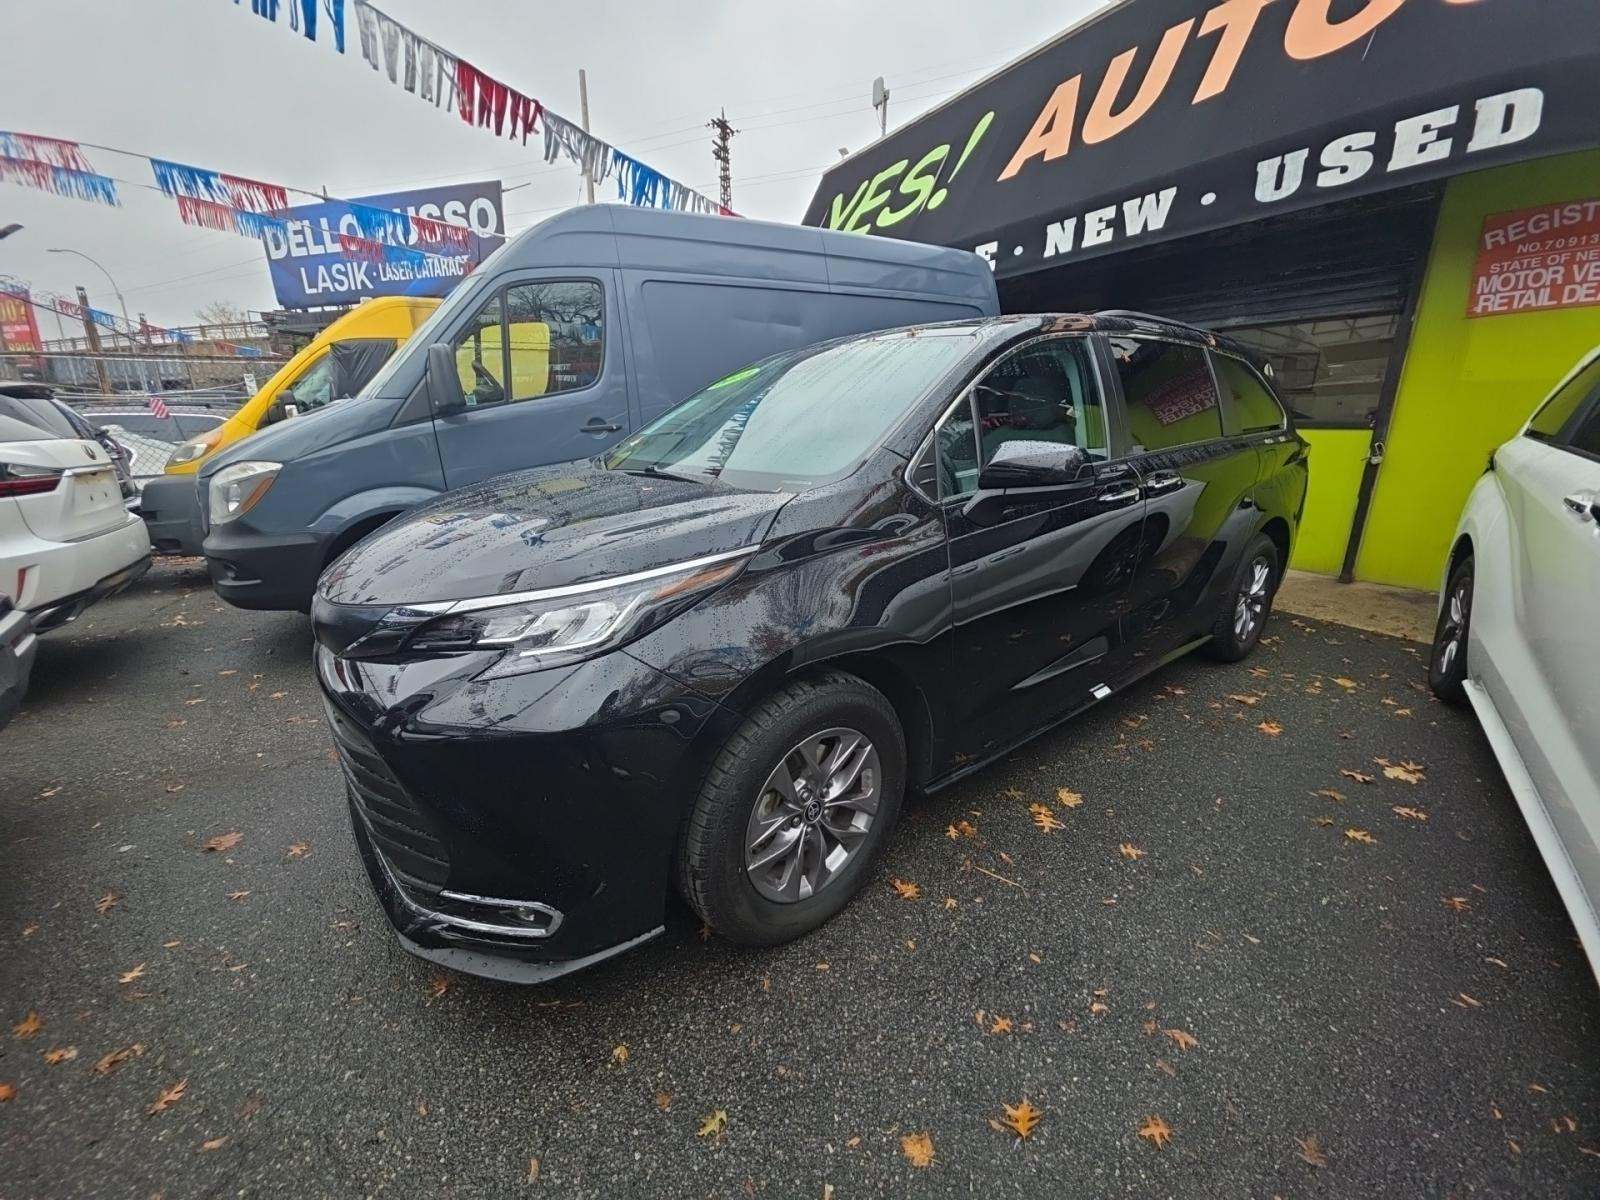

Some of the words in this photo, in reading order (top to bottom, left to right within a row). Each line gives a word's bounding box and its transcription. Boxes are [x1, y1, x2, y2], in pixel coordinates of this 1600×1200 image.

[828, 110, 995, 234] YES!
[1042, 186, 1178, 259] NEW
[1253, 87, 1545, 204] USED
[264, 212, 364, 260] DELLO
[300, 261, 374, 295] LASIK
[1489, 256, 1541, 274] STATE
[1546, 252, 1571, 266] OF
[1474, 286, 1558, 313] RETAIL
[1561, 282, 1600, 304] DE
[1476, 266, 1565, 295] MOTOR
